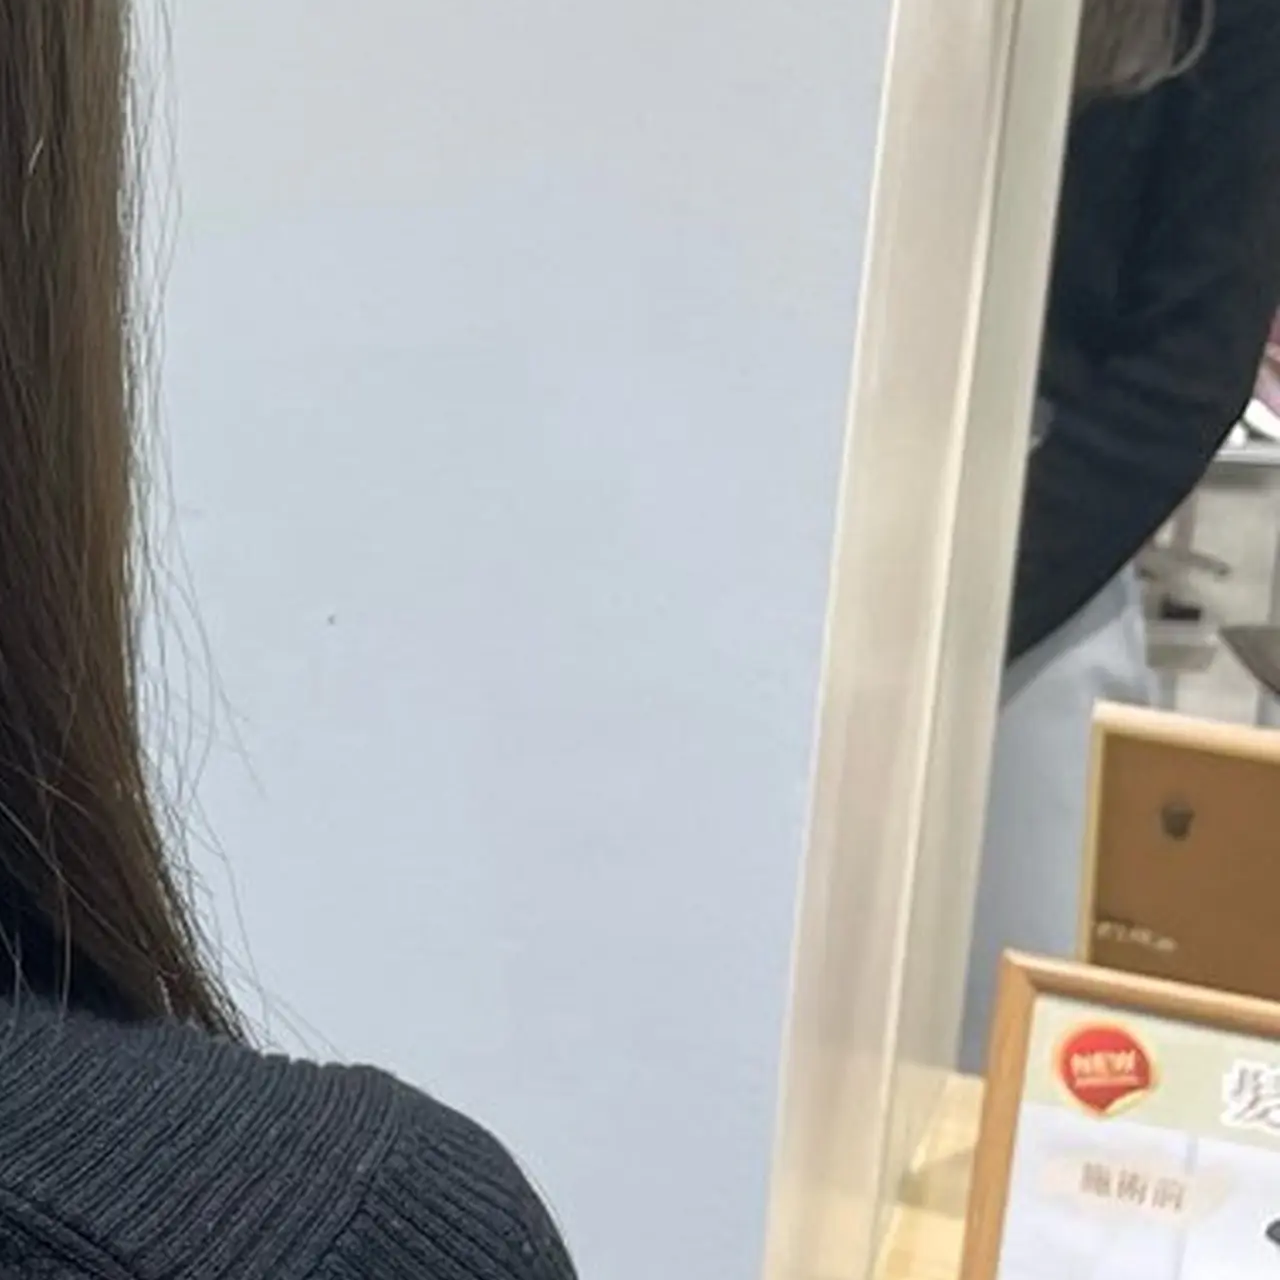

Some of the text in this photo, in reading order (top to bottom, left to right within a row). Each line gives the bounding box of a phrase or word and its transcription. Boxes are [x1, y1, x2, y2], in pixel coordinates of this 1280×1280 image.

[1071, 1049, 1137, 1079] NEW
[1081, 1163, 1185, 1211] 施術前
